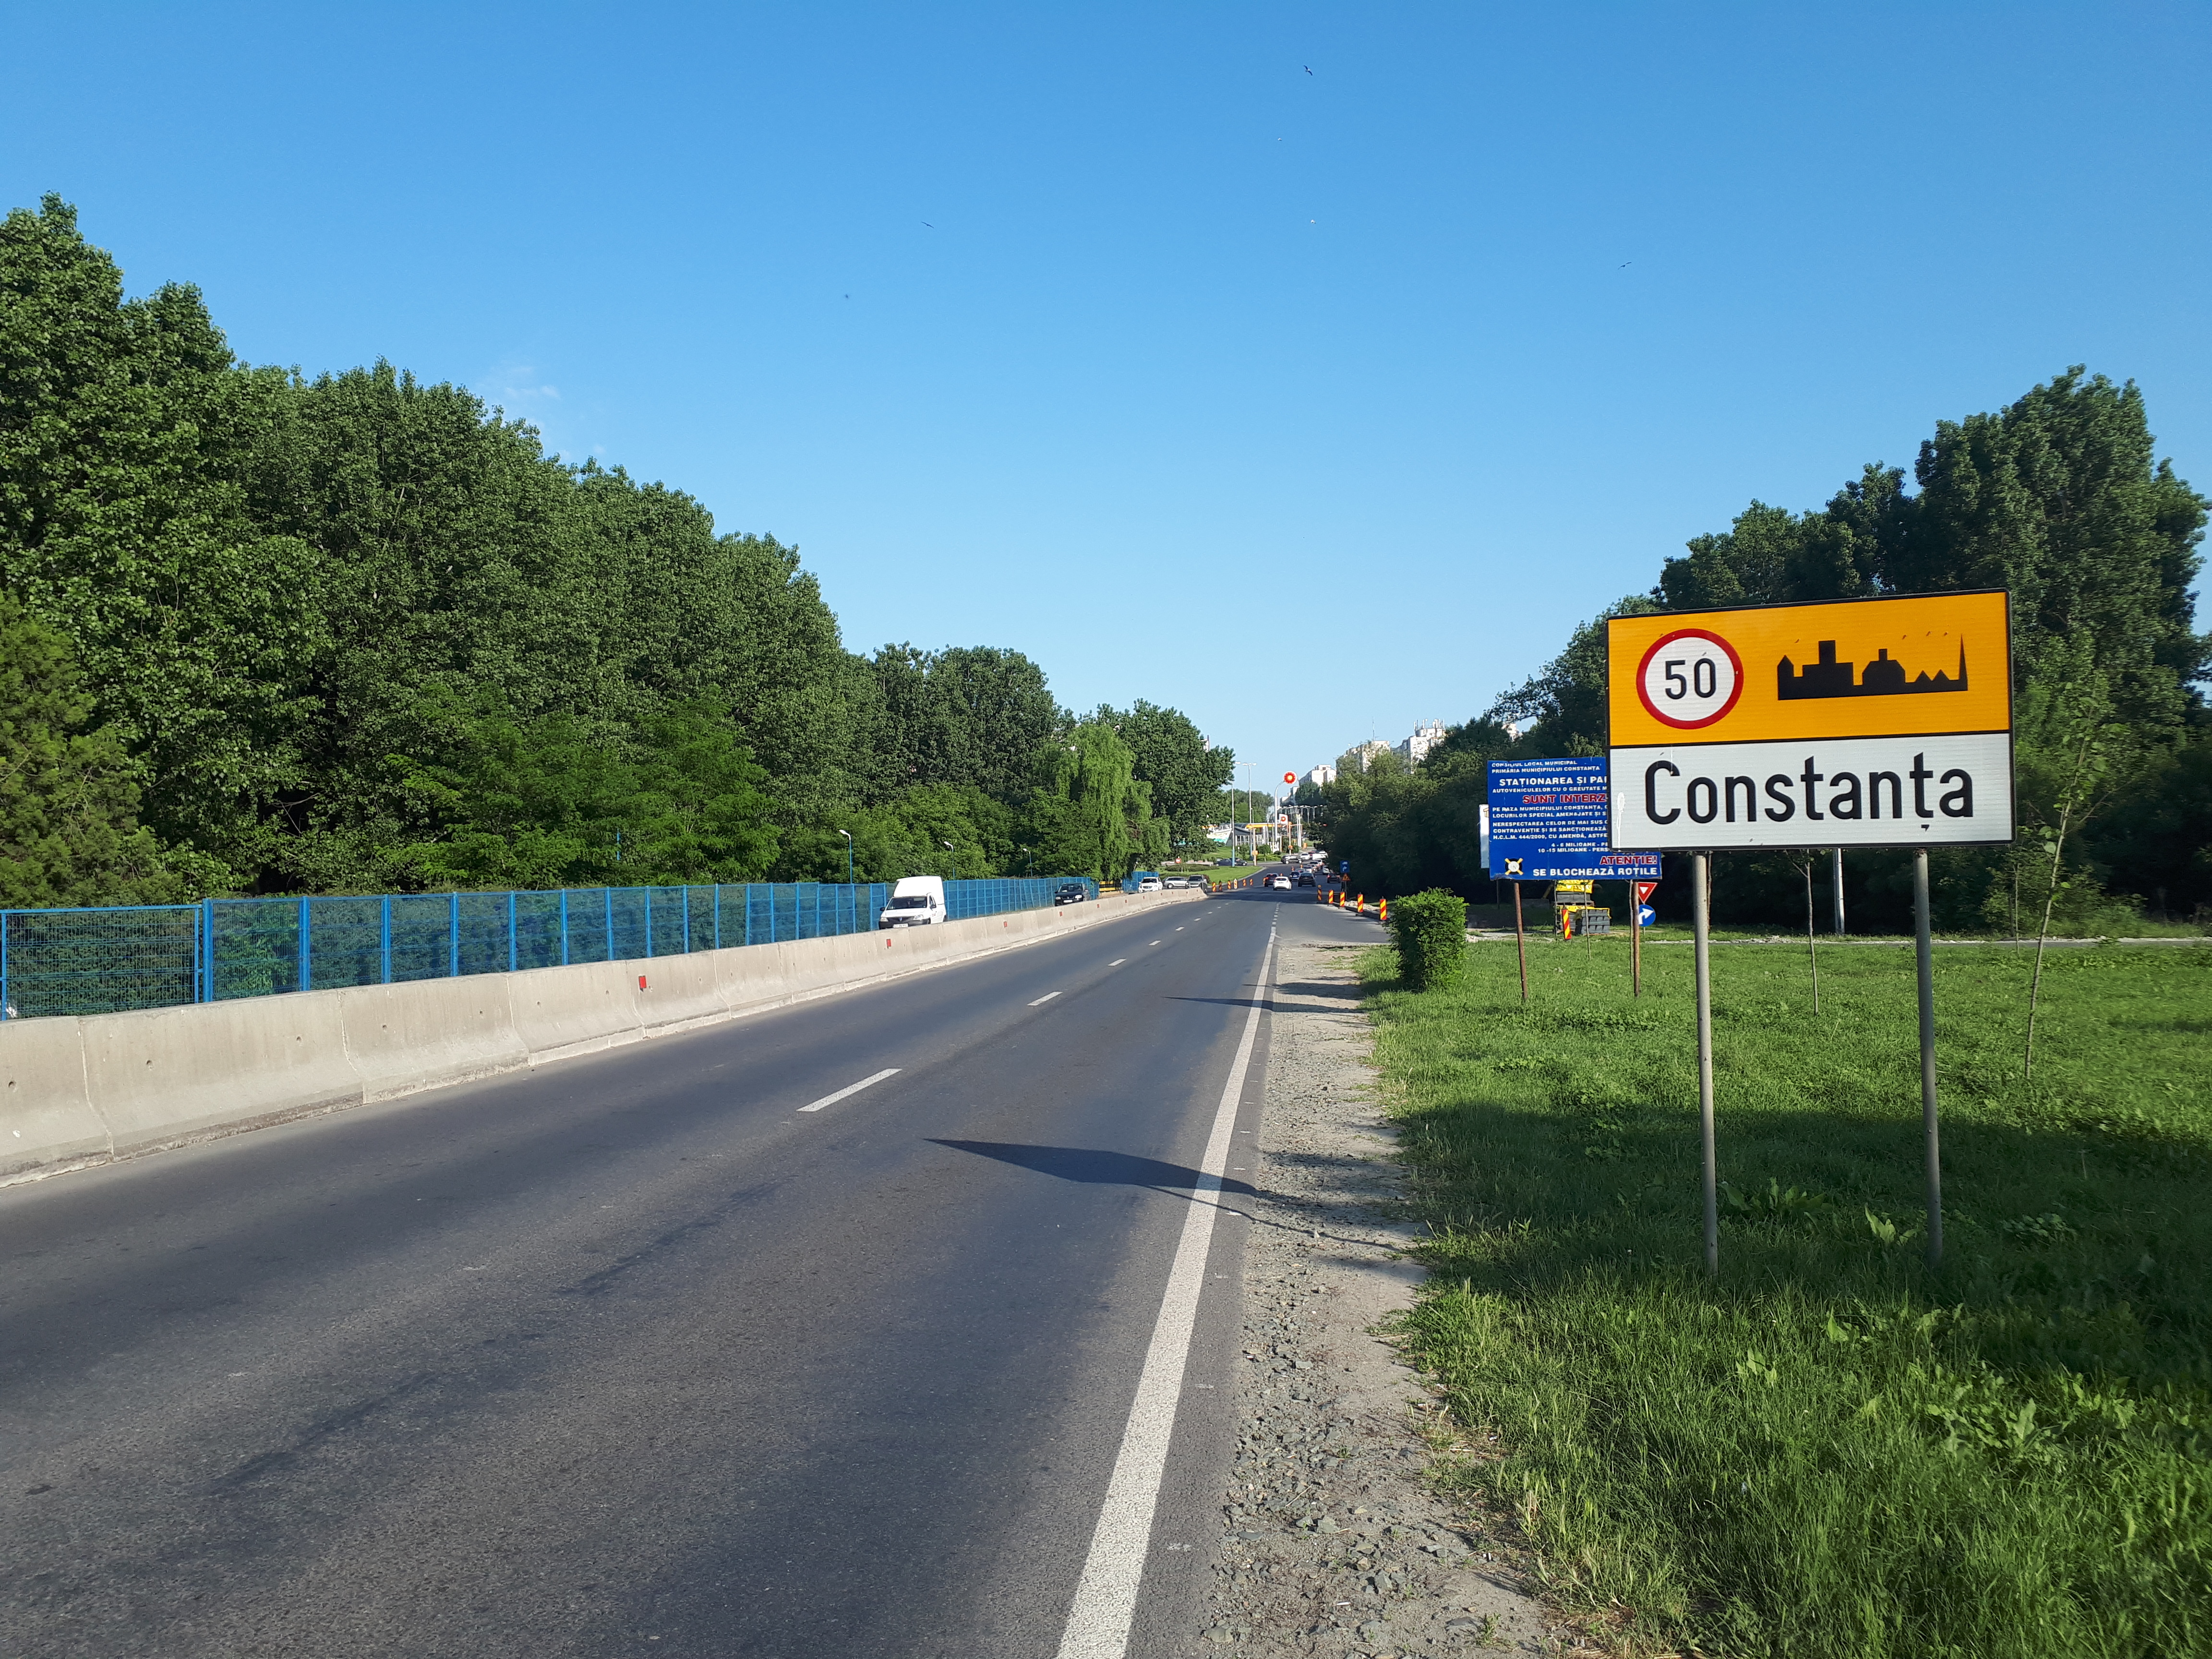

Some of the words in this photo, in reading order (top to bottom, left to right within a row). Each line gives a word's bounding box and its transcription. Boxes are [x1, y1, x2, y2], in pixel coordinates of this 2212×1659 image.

[1665, 657, 1716, 700] 50
[1499, 777, 1573, 787] STAȚIONAREA
[1576, 776, 1587, 786] ȘI
[1644, 752, 1974, 832] Constanța
[1522, 794, 1557, 804] SUNT
[1560, 793, 1608, 803] INTERZ
[1599, 855, 1658, 867] ATENȚIE!
[1550, 866, 1614, 876] BLOCHEAZĂ
[1617, 867, 1658, 877] ROȚILE
